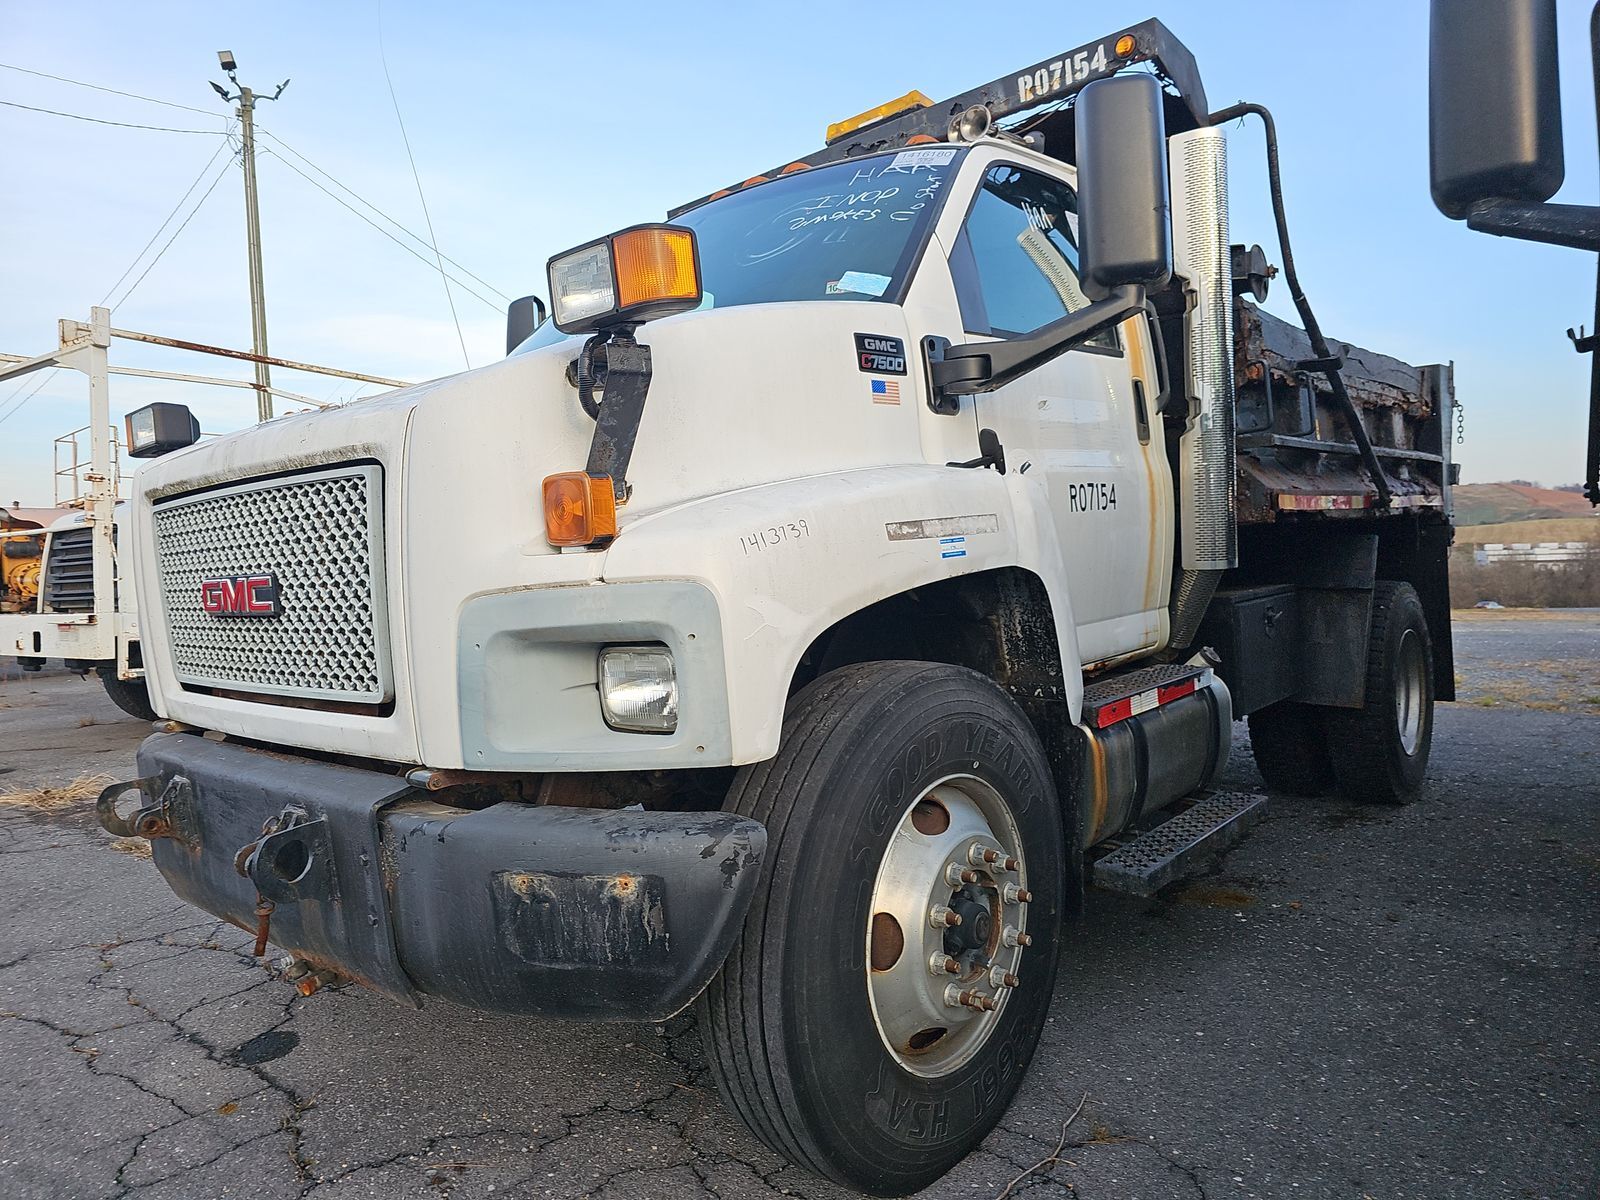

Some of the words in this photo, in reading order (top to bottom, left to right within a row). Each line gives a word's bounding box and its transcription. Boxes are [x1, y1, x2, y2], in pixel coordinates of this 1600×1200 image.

[864, 338, 897, 353] GMC
[861, 353, 904, 371] C7500
[1069, 482, 1117, 512] R07154
[740, 518, 810, 555] 1413739
[202, 576, 274, 612] GMC
